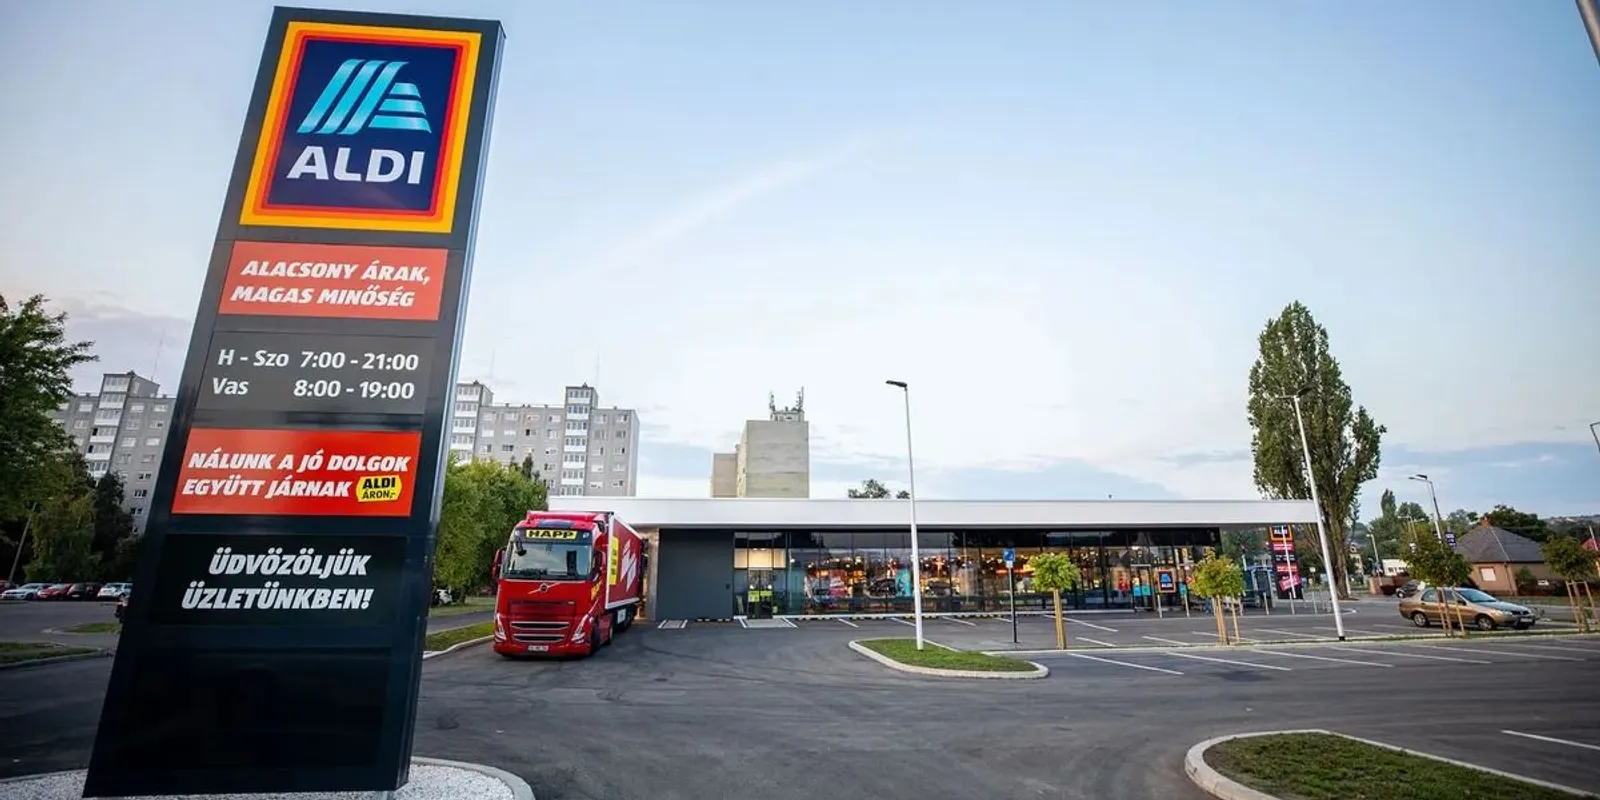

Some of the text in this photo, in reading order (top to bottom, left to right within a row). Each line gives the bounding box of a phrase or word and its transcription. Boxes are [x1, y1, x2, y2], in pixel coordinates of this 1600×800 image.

[286, 145, 425, 184] ALDI
[240, 260, 431, 286] ALACSONY ÁRAK,
[230, 284, 415, 307] MAGAS MINŐSÉG
[217, 349, 235, 366] H
[253, 350, 289, 368] Szo
[300, 350, 346, 369] 7:00
[361, 353, 419, 371] 21:00
[212, 377, 249, 395] Vas
[293, 379, 342, 398] 8:00
[358, 381, 415, 399] 19:00
[188, 447, 411, 473] NÁLUNK A JÓ DOLGOK
[182, 474, 353, 499] EGYÜTT JÁRNAK
[362, 477, 396, 489] ALDI
[528, 530, 574, 538] HAPP
[208, 547, 372, 579] ÜDVÖZÖLJÜK
[181, 581, 374, 610] ÜZLETÜNKBEN!
